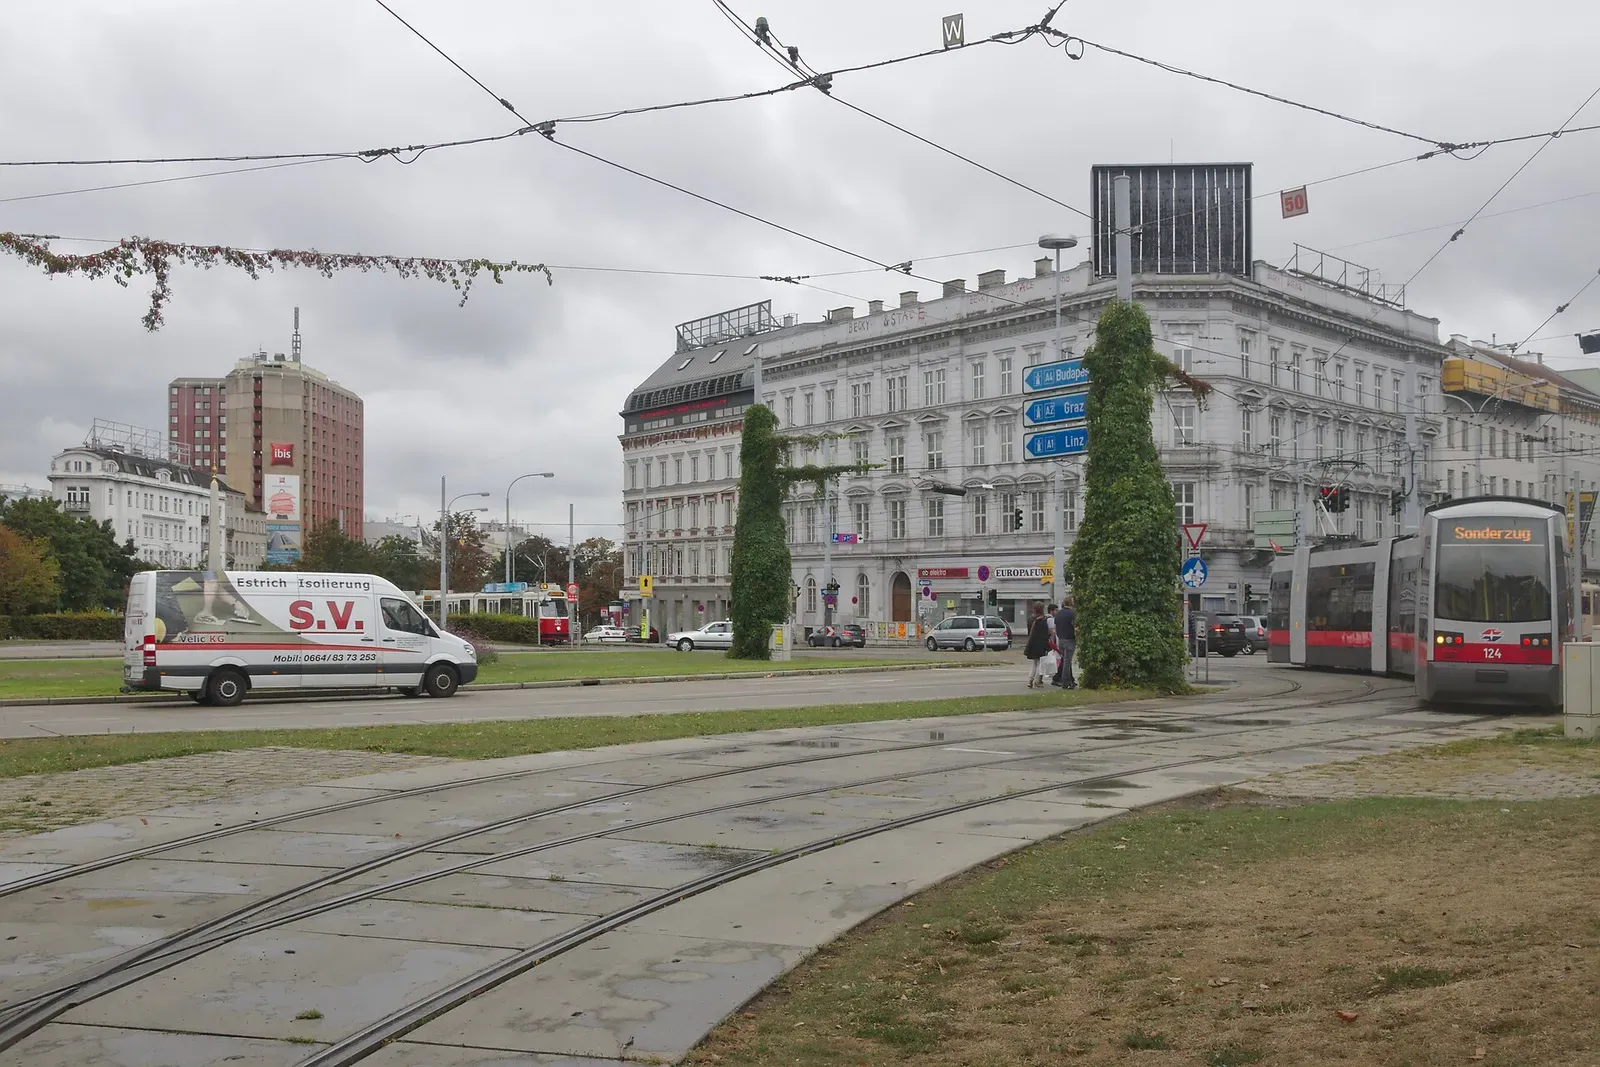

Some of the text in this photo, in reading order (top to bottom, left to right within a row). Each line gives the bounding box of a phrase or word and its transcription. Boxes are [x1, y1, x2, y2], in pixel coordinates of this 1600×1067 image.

[944, 19, 962, 41] W
[1284, 194, 1304, 212] 50
[848, 320, 869, 334] BECKY
[1045, 371, 1053, 382] A4
[1045, 402, 1084, 415] A2 Graz
[1047, 436, 1084, 448] A1 Linz
[274, 448, 291, 459] ibis
[1454, 526, 1531, 541] Sonderzug
[995, 568, 1053, 577] EUROPAFUNK
[237, 578, 370, 591] Estrich Isolierung
[289, 600, 363, 629] S.V.
[346, 654, 357, 662] 73
[1483, 648, 1502, 659] 124
